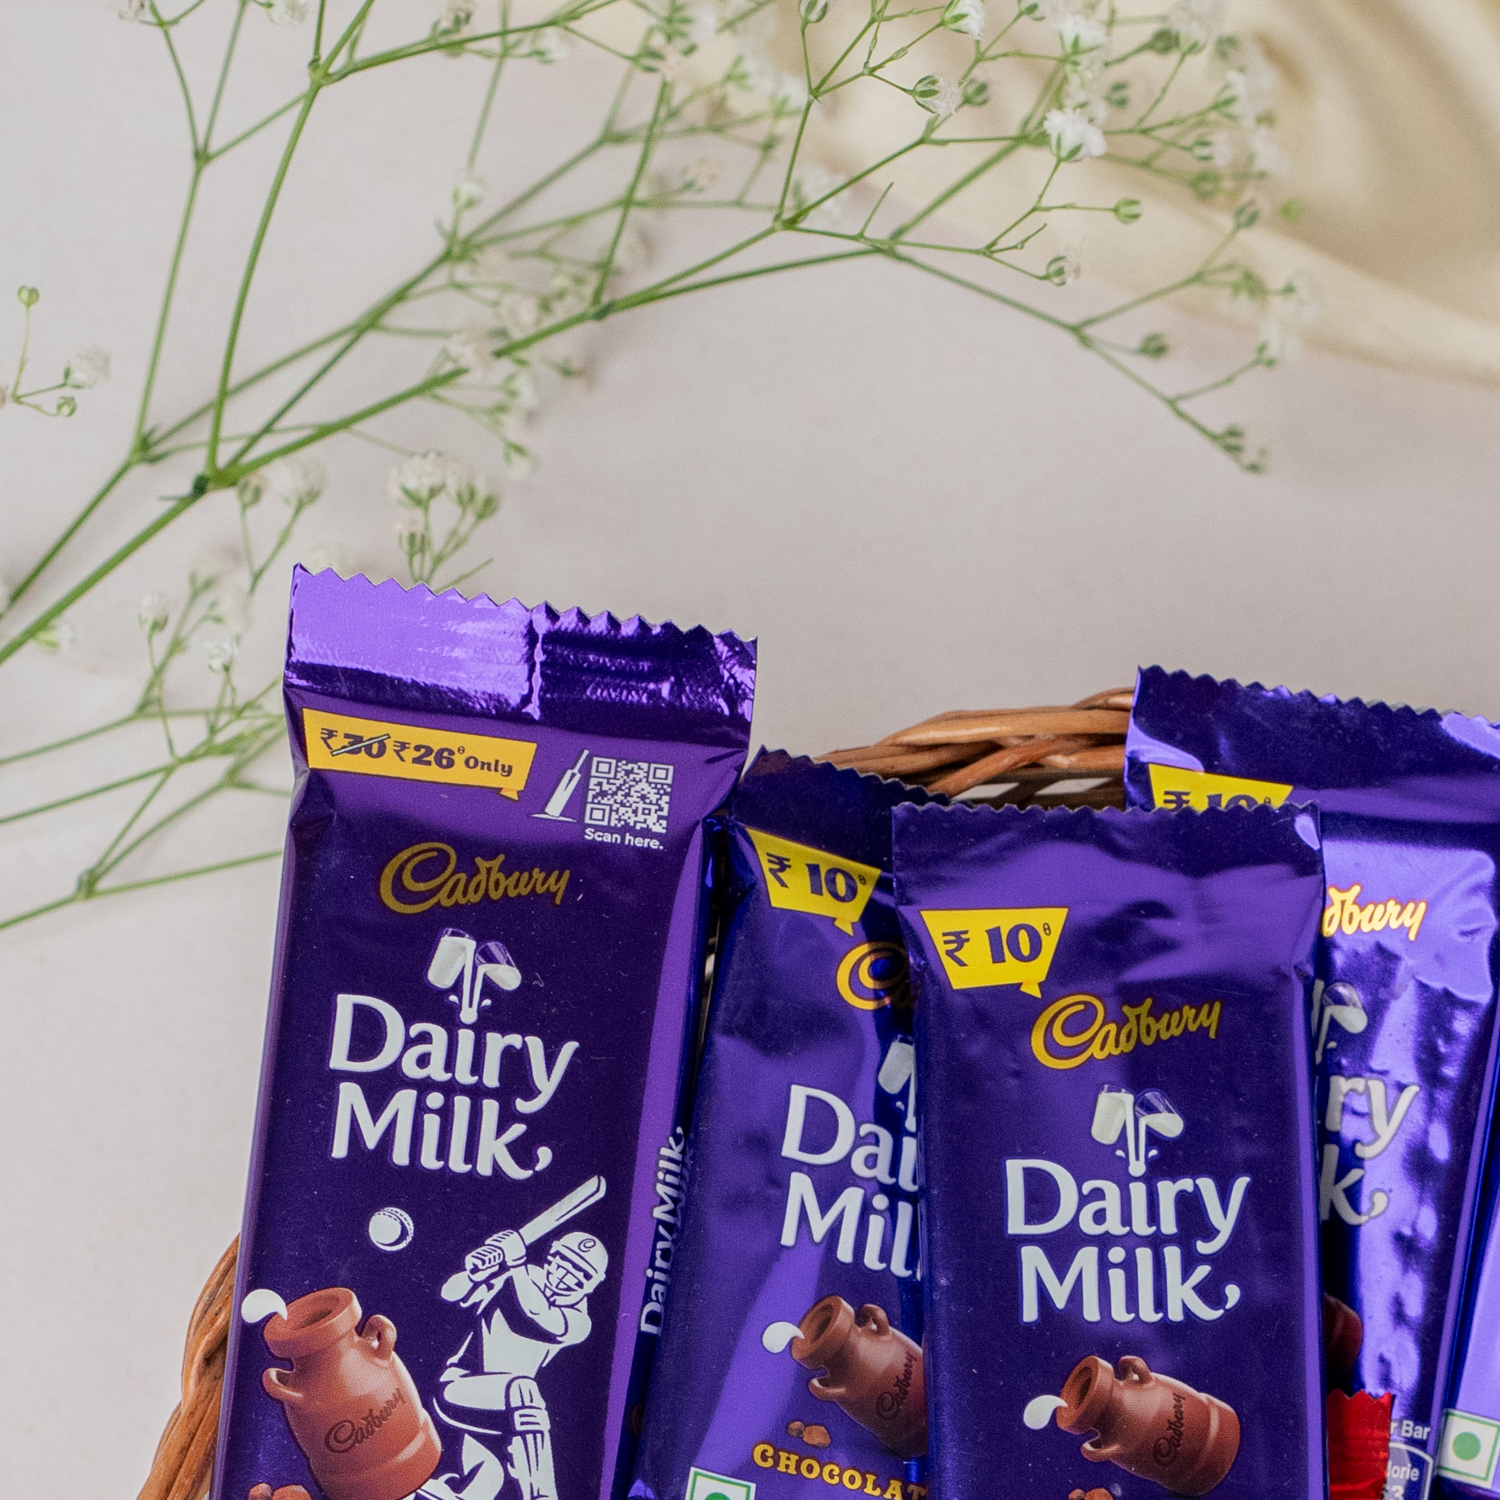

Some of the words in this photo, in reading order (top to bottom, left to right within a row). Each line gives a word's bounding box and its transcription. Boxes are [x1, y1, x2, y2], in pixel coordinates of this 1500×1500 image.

[464, 756, 513, 777] Only
[380, 842, 570, 915] Cadbury
[584, 828, 621, 844] Scan
[625, 832, 664, 850] here.
[1322, 884, 1427, 941] dbury
[328, 992, 581, 1115] Dairy
[1031, 993, 1223, 1070] Cadbury
[331, 1081, 554, 1181] Milk
[780, 1083, 917, 1194] Dai
[652, 1126, 685, 1224] Milk
[1004, 1157, 1251, 1256] Dairy
[779, 1171, 920, 1279] Mil
[639, 1224, 673, 1336] Dairy
[1019, 1243, 1242, 1324] Milk
[323, 1386, 404, 1455] Cadbury
[1401, 1421, 1430, 1441] Bar
